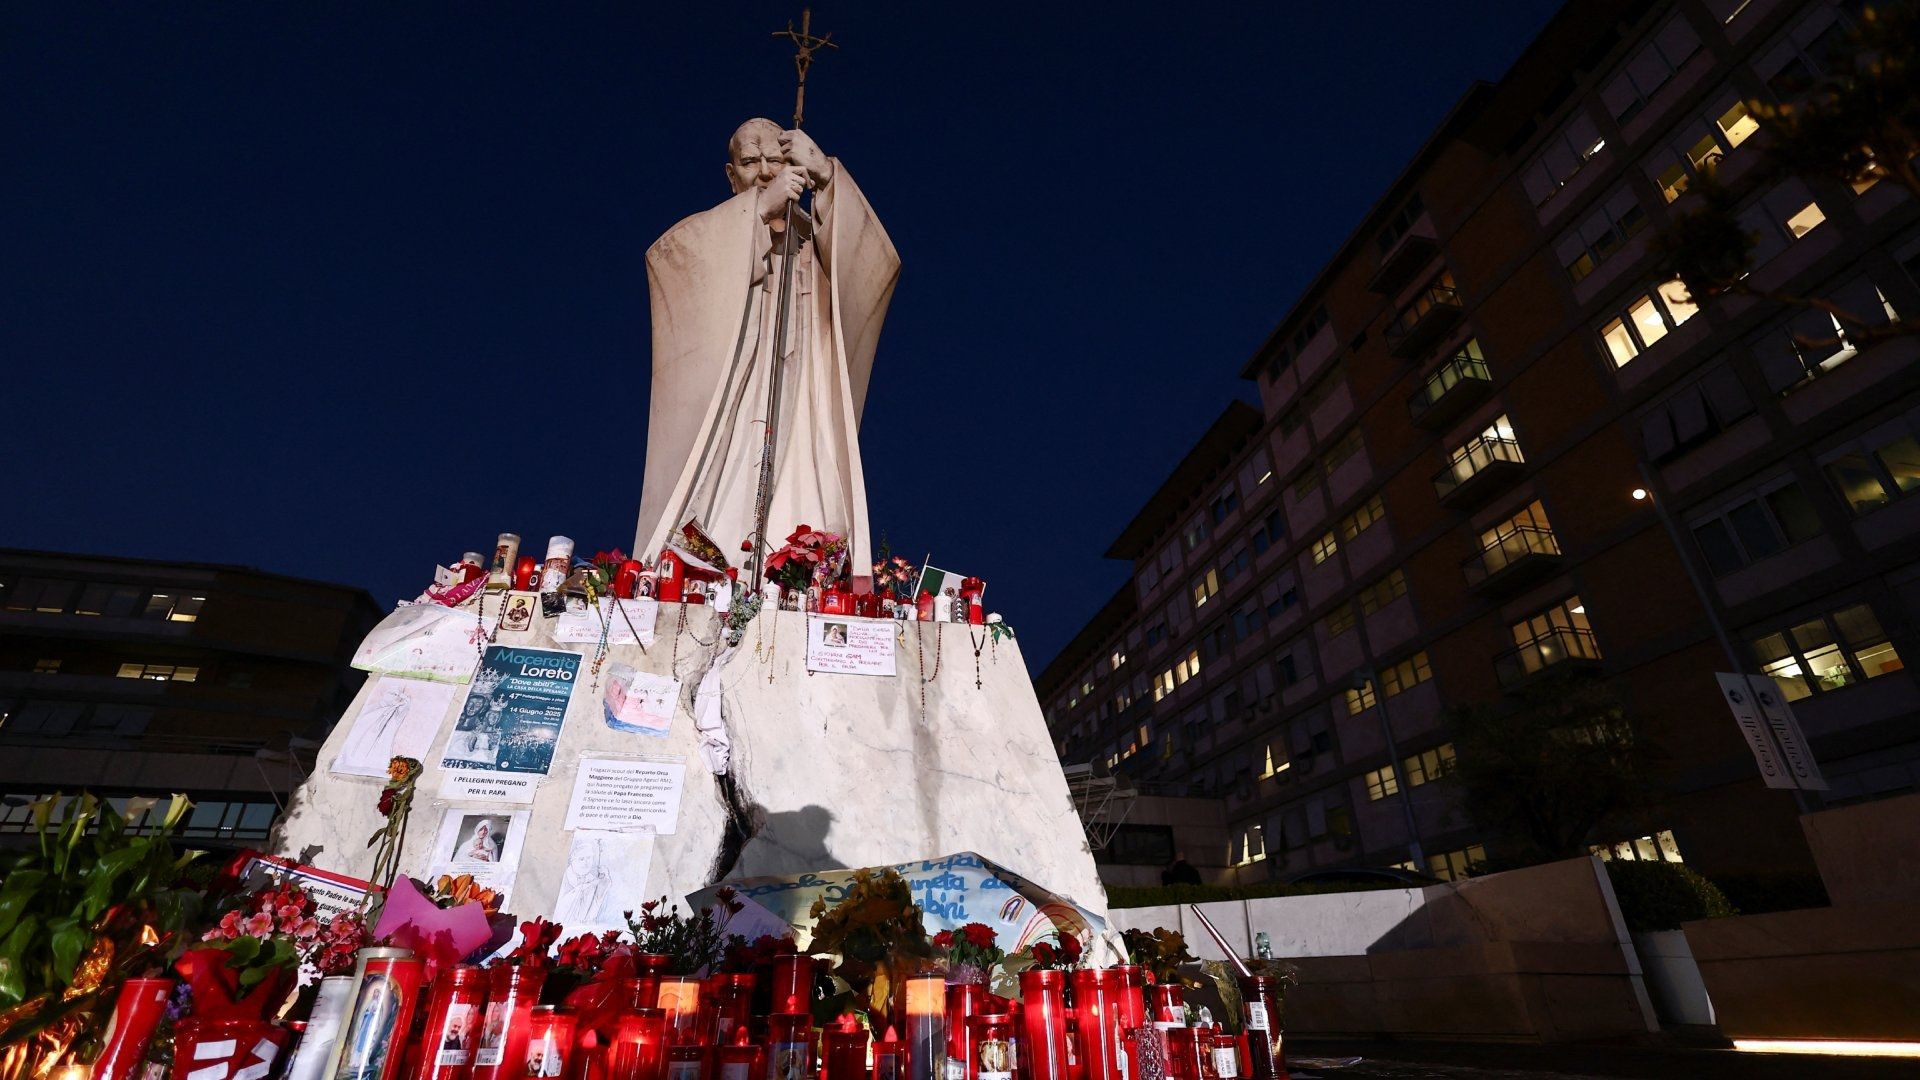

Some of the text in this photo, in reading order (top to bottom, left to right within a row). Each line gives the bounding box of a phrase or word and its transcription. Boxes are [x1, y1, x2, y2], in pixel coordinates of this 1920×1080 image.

[495, 649, 576, 669] Macerata
[520, 664, 572, 680] Loreto
[1741, 715, 1776, 777] Gemelli
[1771, 718, 1808, 778] Gemelli
[309, 886, 325, 895] Santo
[325, 891, 343, 900] Padre
